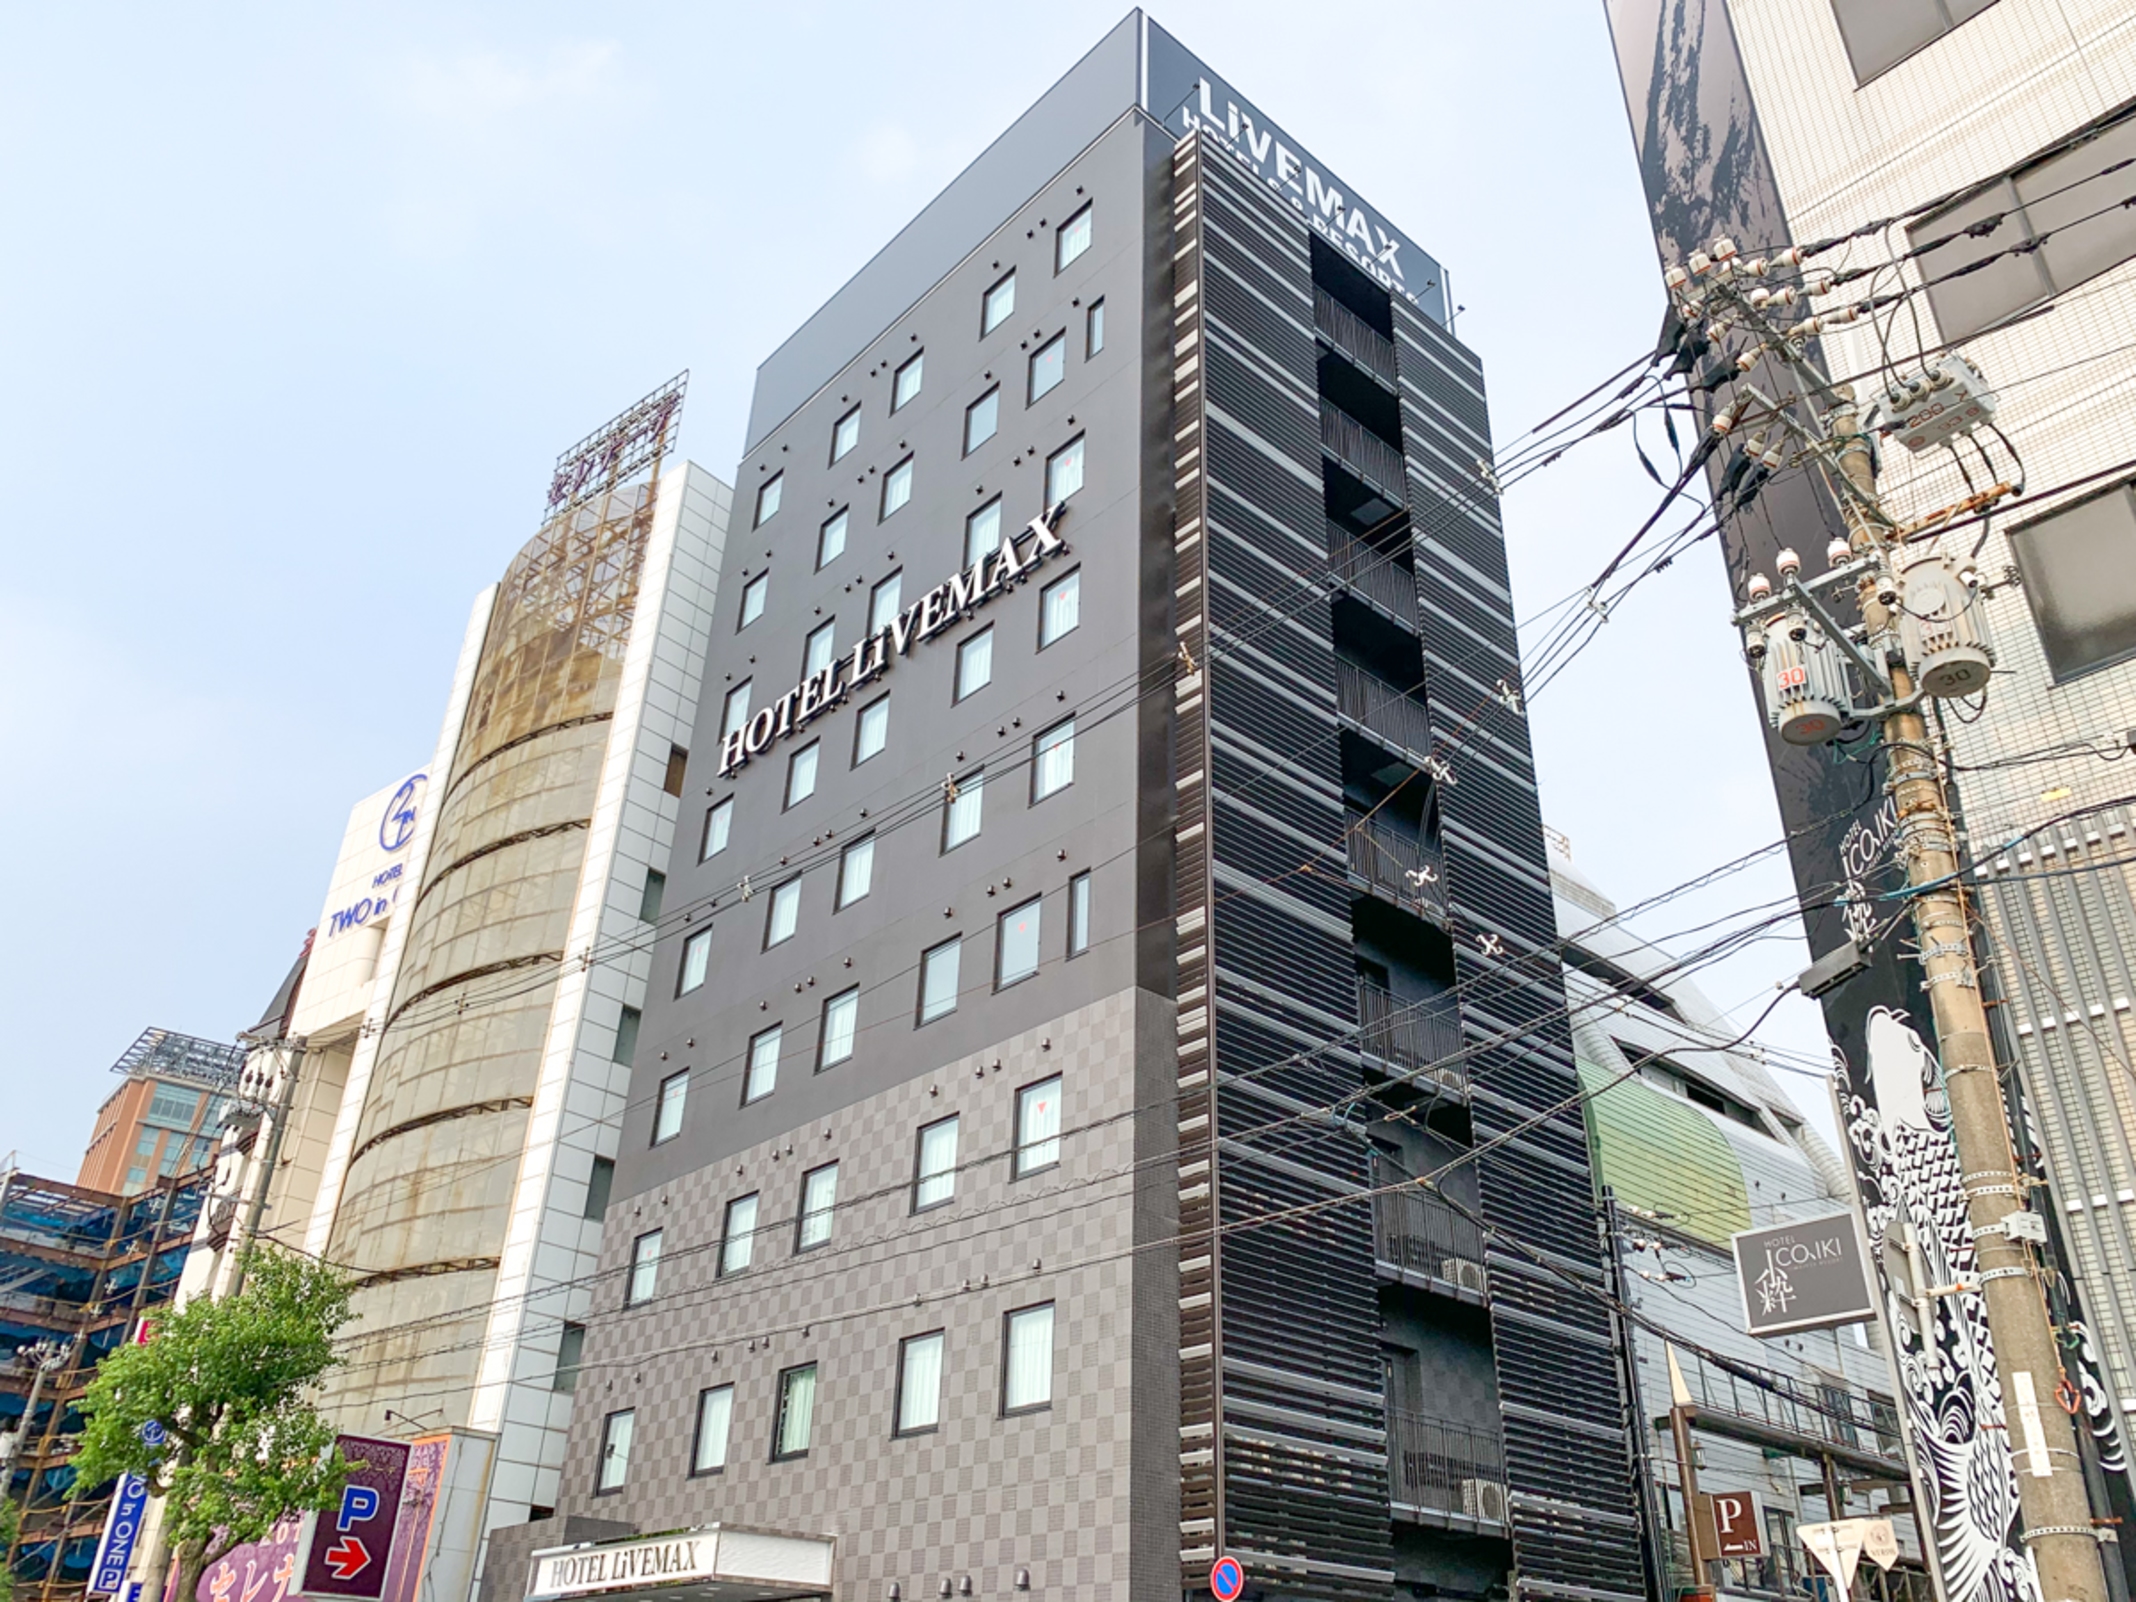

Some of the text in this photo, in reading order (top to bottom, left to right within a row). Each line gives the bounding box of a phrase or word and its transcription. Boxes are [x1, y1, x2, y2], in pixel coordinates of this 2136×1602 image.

[1906, 402, 1945, 429] 200
[1778, 666, 1805, 689] 30
[1939, 668, 1971, 687] 30
[717, 658, 847, 778] HOTEL
[1794, 717, 1825, 735] 30
[328, 897, 388, 938] TWO in
[1763, 1235, 1796, 1249] HOTEL
[336, 1484, 380, 1532] P
[1717, 1499, 1742, 1533] P
[106, 1521, 133, 1566] ONE
[1744, 1540, 1758, 1552] IN
[550, 1553, 607, 1588] HOTEL
